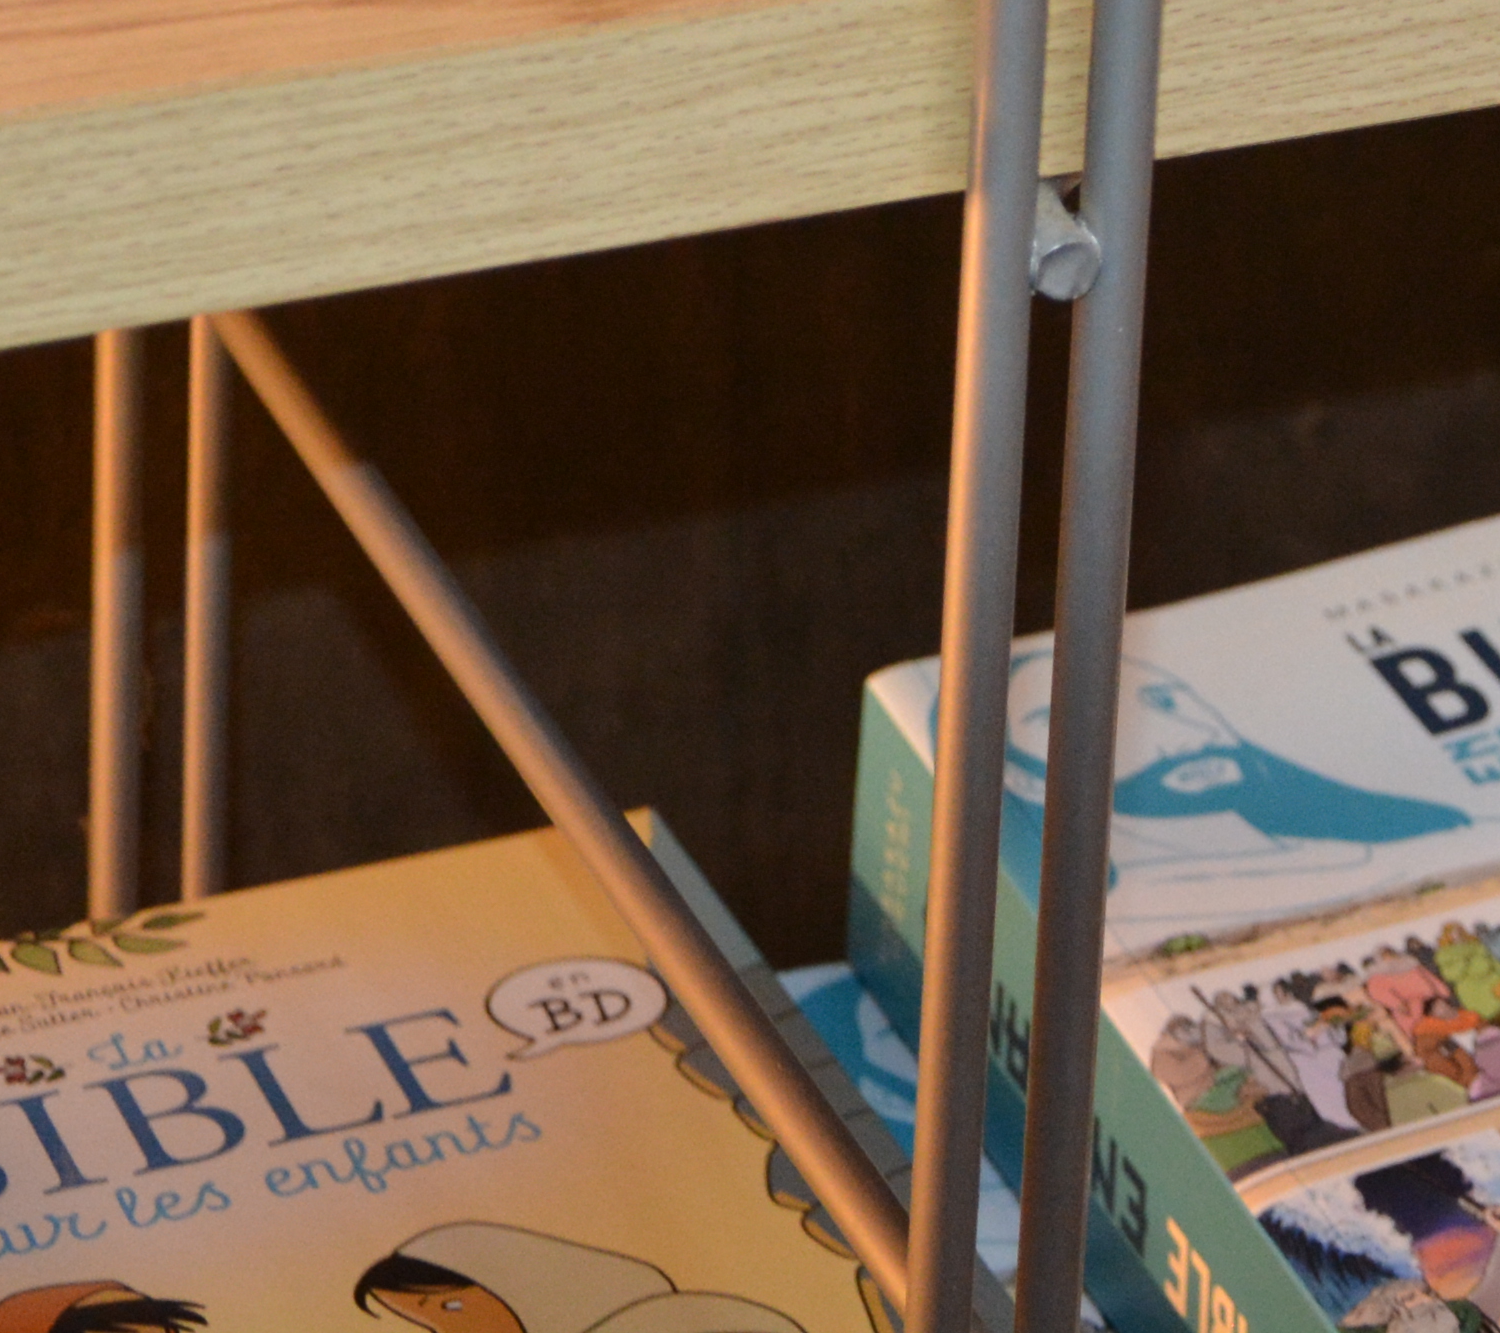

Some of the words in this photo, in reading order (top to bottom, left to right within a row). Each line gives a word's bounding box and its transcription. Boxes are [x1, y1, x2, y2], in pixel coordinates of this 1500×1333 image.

[1344, 621, 1393, 657] LA
[545, 967, 593, 990] en
[528, 981, 635, 1037] BD
[86, 1030, 184, 1074] La
[115, 1178, 232, 1232] les
[264, 1106, 546, 1197] enfants
